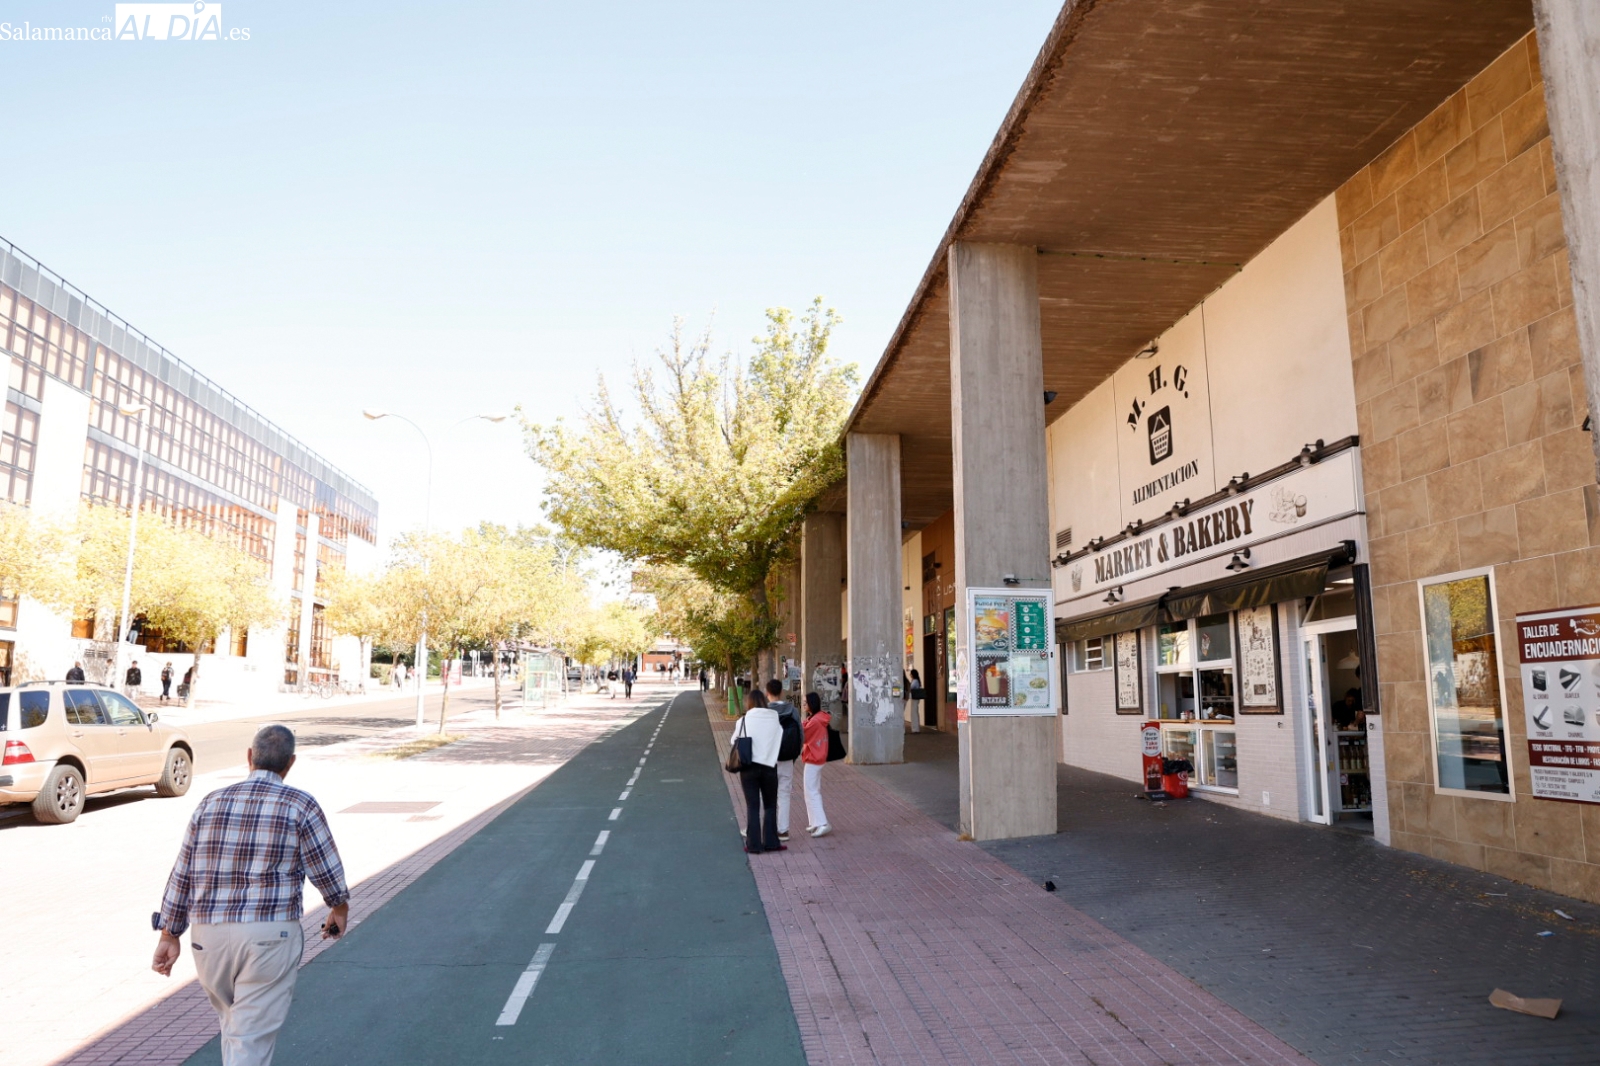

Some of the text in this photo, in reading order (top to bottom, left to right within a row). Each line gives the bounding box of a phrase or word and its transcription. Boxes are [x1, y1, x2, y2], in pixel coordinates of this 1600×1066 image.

[1132, 459, 1199, 506] ALIMENTACION
[1094, 498, 1255, 585] MARKET & BAKERY
[1523, 623, 1560, 639] TALLER DE
